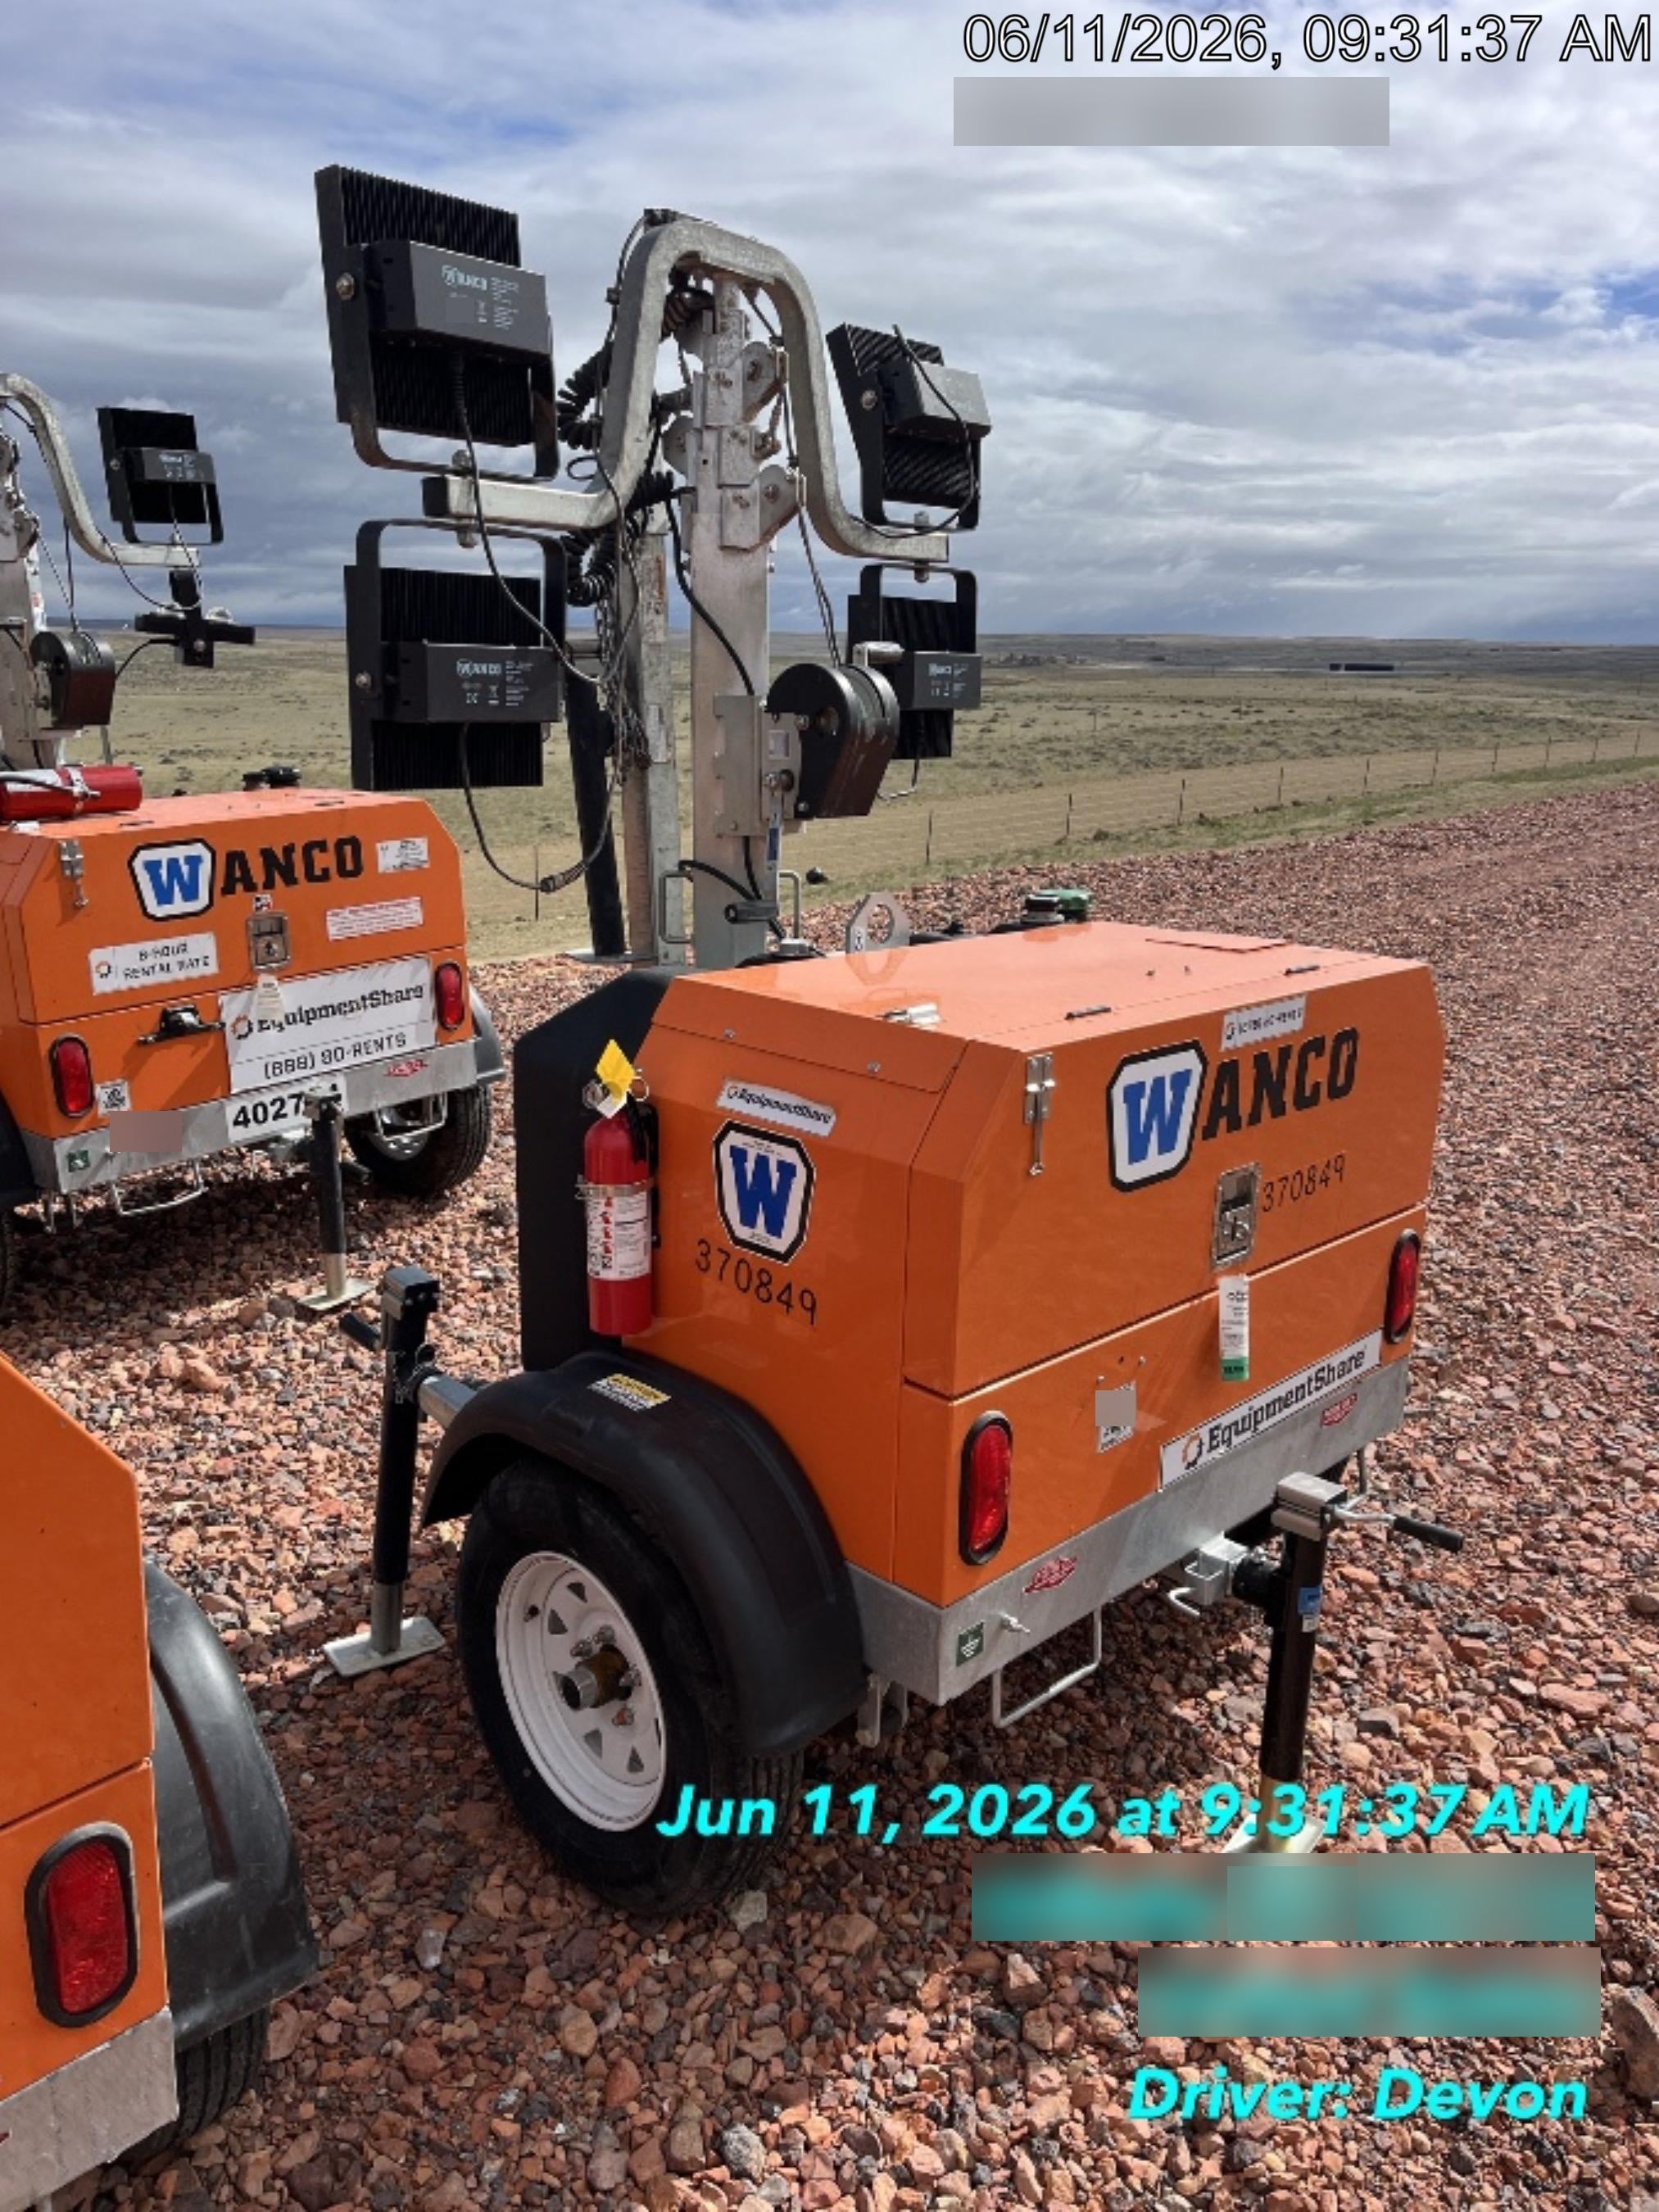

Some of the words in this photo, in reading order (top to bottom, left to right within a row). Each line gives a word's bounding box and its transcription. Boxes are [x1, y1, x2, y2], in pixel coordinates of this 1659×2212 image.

[143, 836, 363, 907] WANCO
[264, 1051, 315, 1079] (888)
[1123, 1027, 1358, 1166] WANCO
[729, 1145, 797, 1239] W
[1262, 1153, 1346, 1213] 370849
[696, 1238, 817, 1326] 370849
[1207, 1350, 1367, 1453] EquipmentShare
